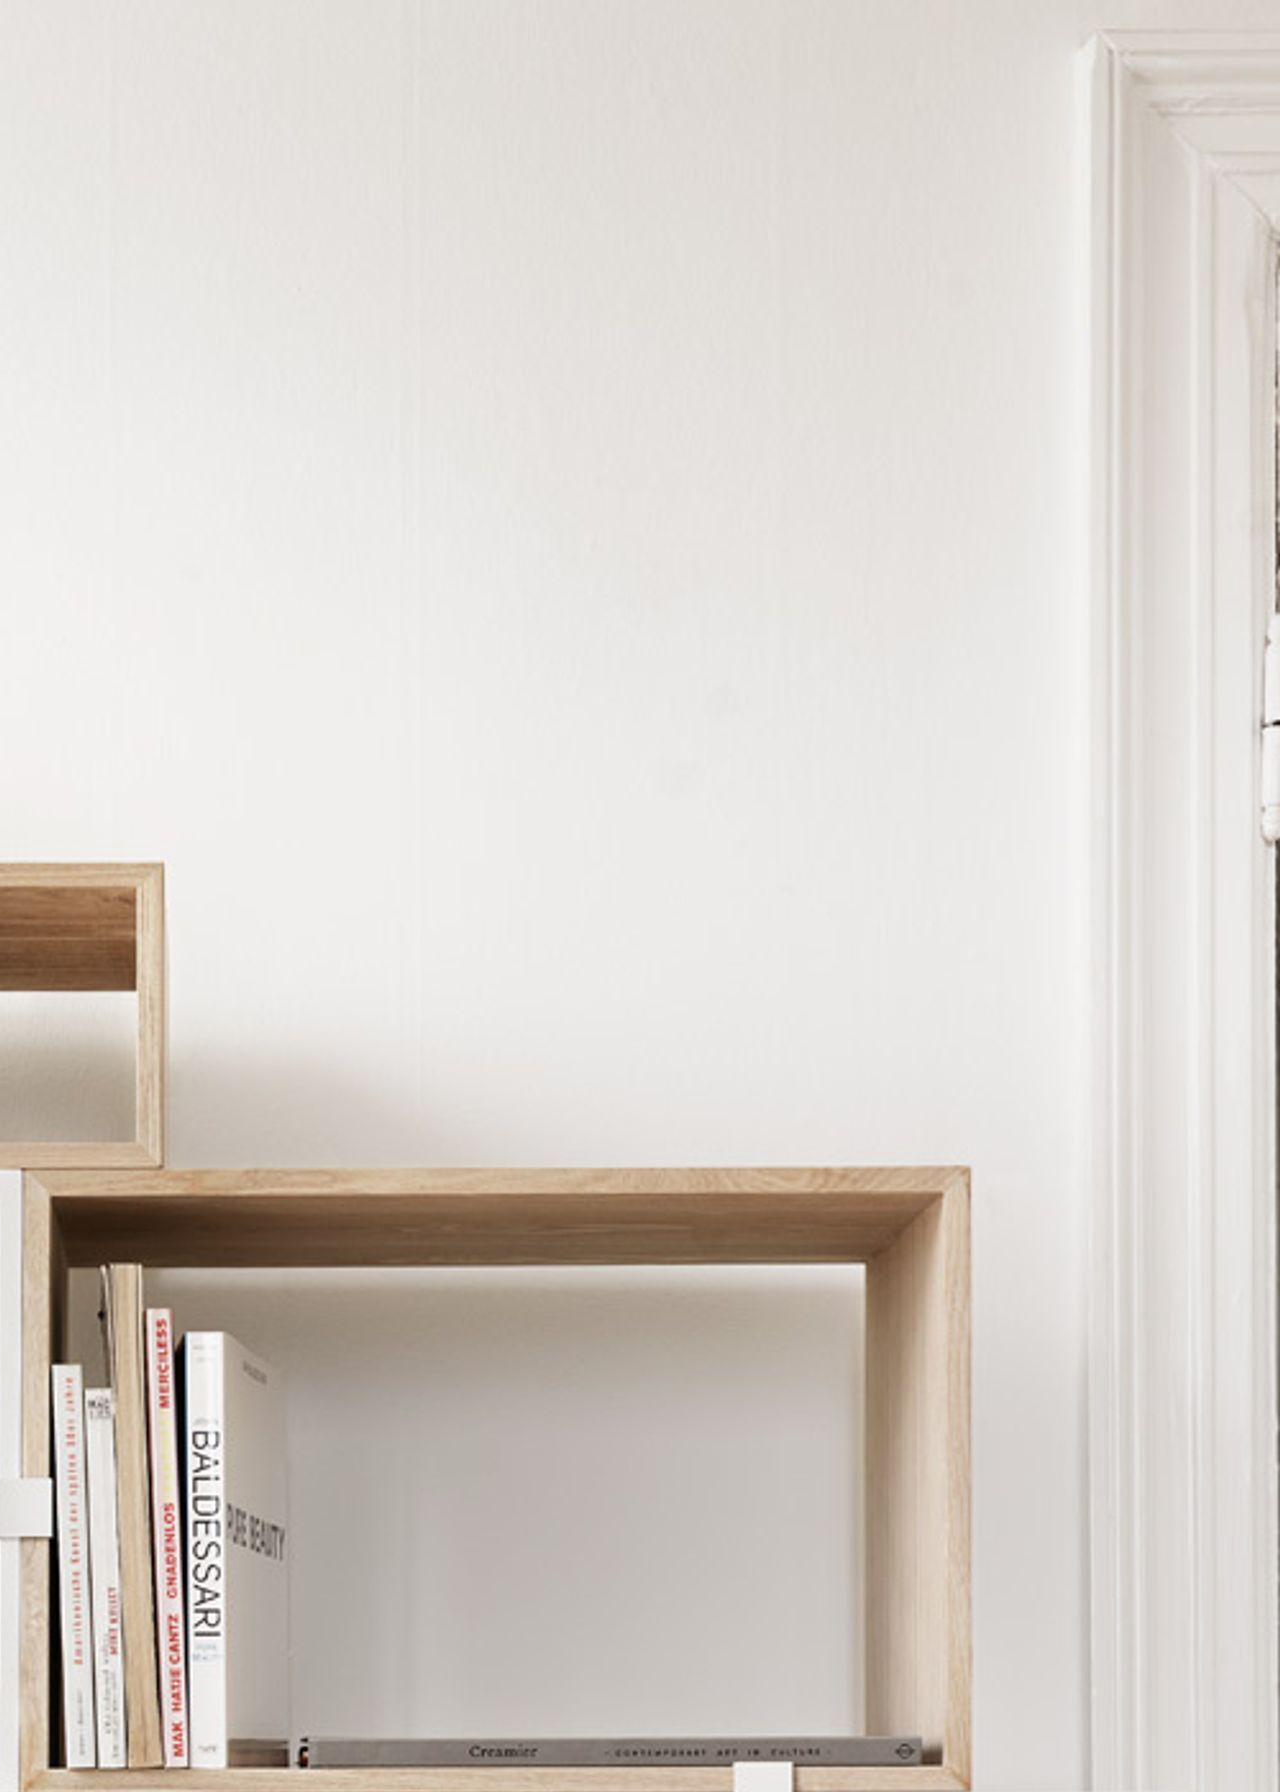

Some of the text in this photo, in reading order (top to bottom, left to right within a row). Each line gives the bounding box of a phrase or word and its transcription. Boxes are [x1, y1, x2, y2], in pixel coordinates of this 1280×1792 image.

[155, 1318, 171, 1409] MERCILESS
[162, 1502, 178, 1599] GNADENLOS
[191, 1431, 222, 1638] BALDESSARI
[167, 1615, 180, 1665] CANTZ
[171, 1721, 184, 1757] MAK
[468, 1745, 538, 1758] Creamier
